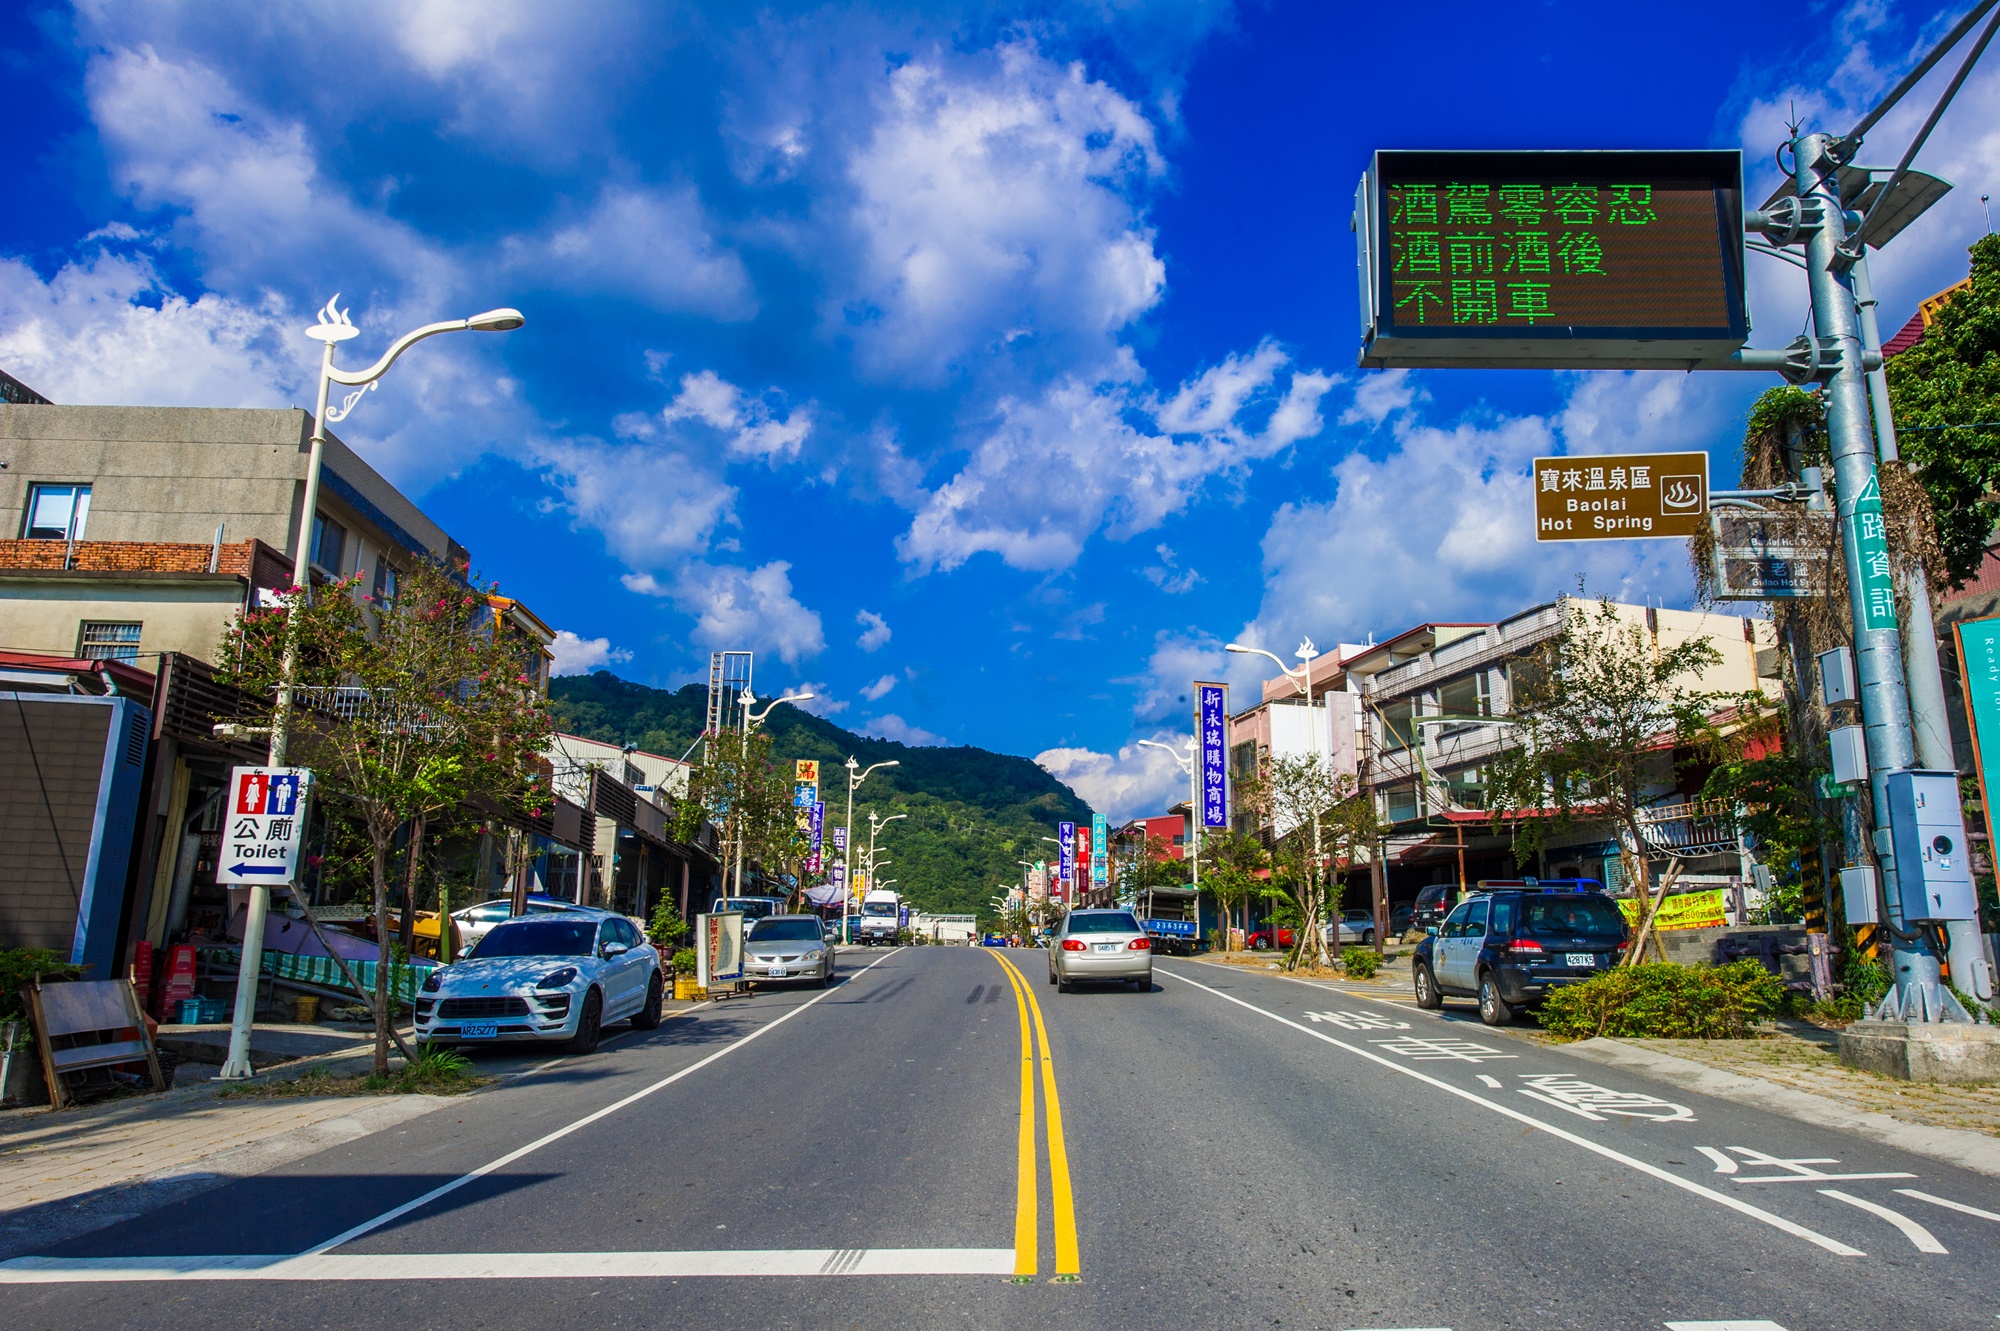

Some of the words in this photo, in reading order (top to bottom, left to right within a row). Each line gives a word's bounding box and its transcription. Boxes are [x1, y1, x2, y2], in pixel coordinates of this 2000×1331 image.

[1390, 182, 1658, 226] 酒駕零容忍
[1392, 231, 1607, 275] 酒前酒後
[1395, 279, 1555, 324] 不開車
[1540, 466, 1651, 493] 寶來溫泉區
[1566, 497, 1627, 512] Baolai
[1541, 517, 1573, 531] Hot
[1593, 516, 1653, 532] Spring
[1985, 637, 1999, 682] Ready
[1204, 689, 1224, 824] 新永瑞購物商場
[233, 818, 294, 841] 公廁
[233, 844, 287, 859] Toilet
